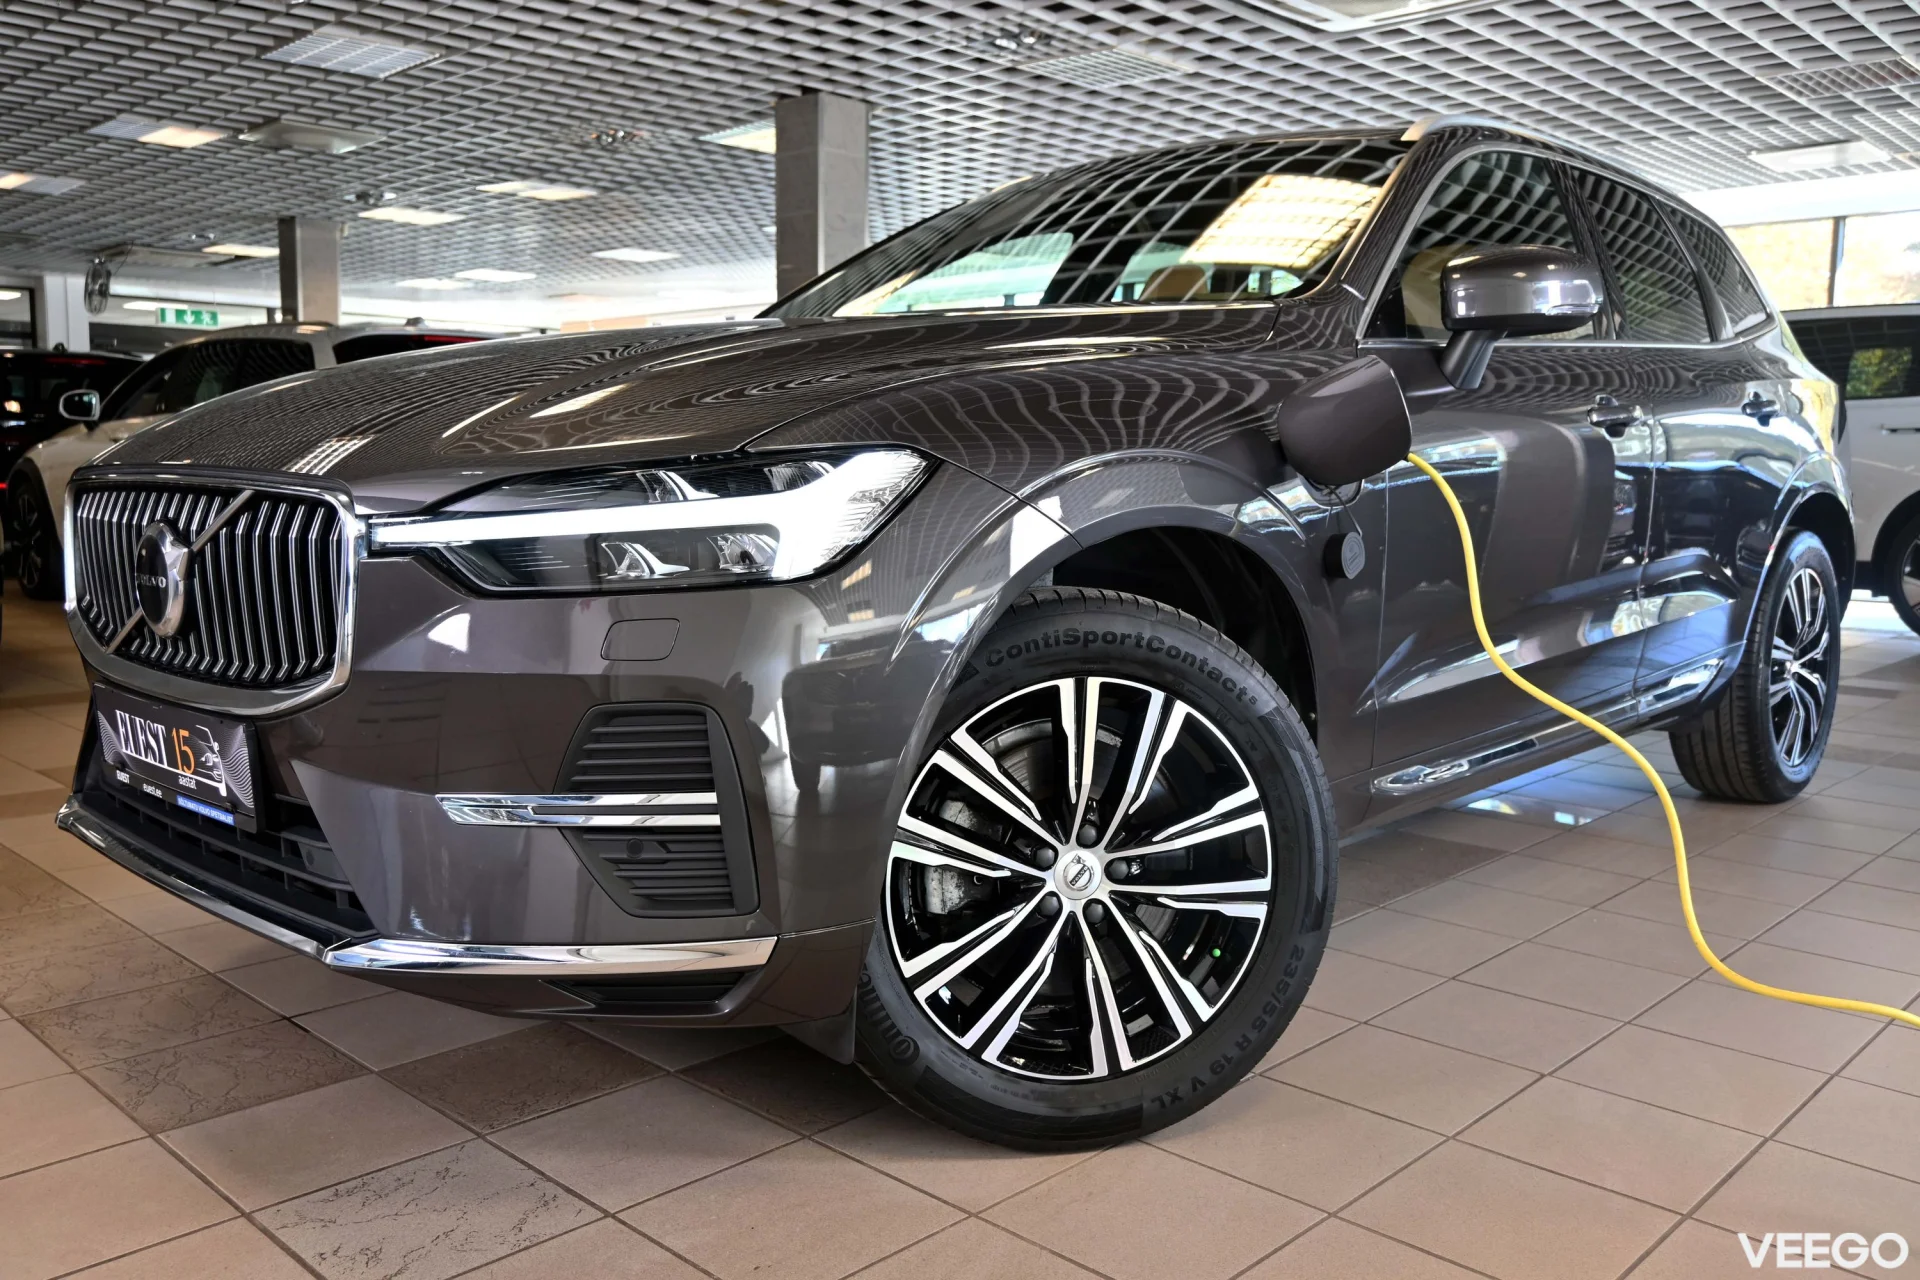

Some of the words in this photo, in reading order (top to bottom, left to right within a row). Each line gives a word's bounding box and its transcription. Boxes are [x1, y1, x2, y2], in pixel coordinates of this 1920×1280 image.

[136, 573, 166, 588] VOLVO
[985, 627, 1249, 703] ContiSportContact
[172, 727, 195, 774] 15
[178, 775, 197, 789] aastat
[1071, 865, 1090, 886] VOLVO
[1250, 943, 1305, 1034] 235/55
[1234, 1031, 1253, 1051] R
[1209, 1050, 1235, 1076] 19
[1190, 1075, 1208, 1093] V
[1151, 1086, 1185, 1110] XL
